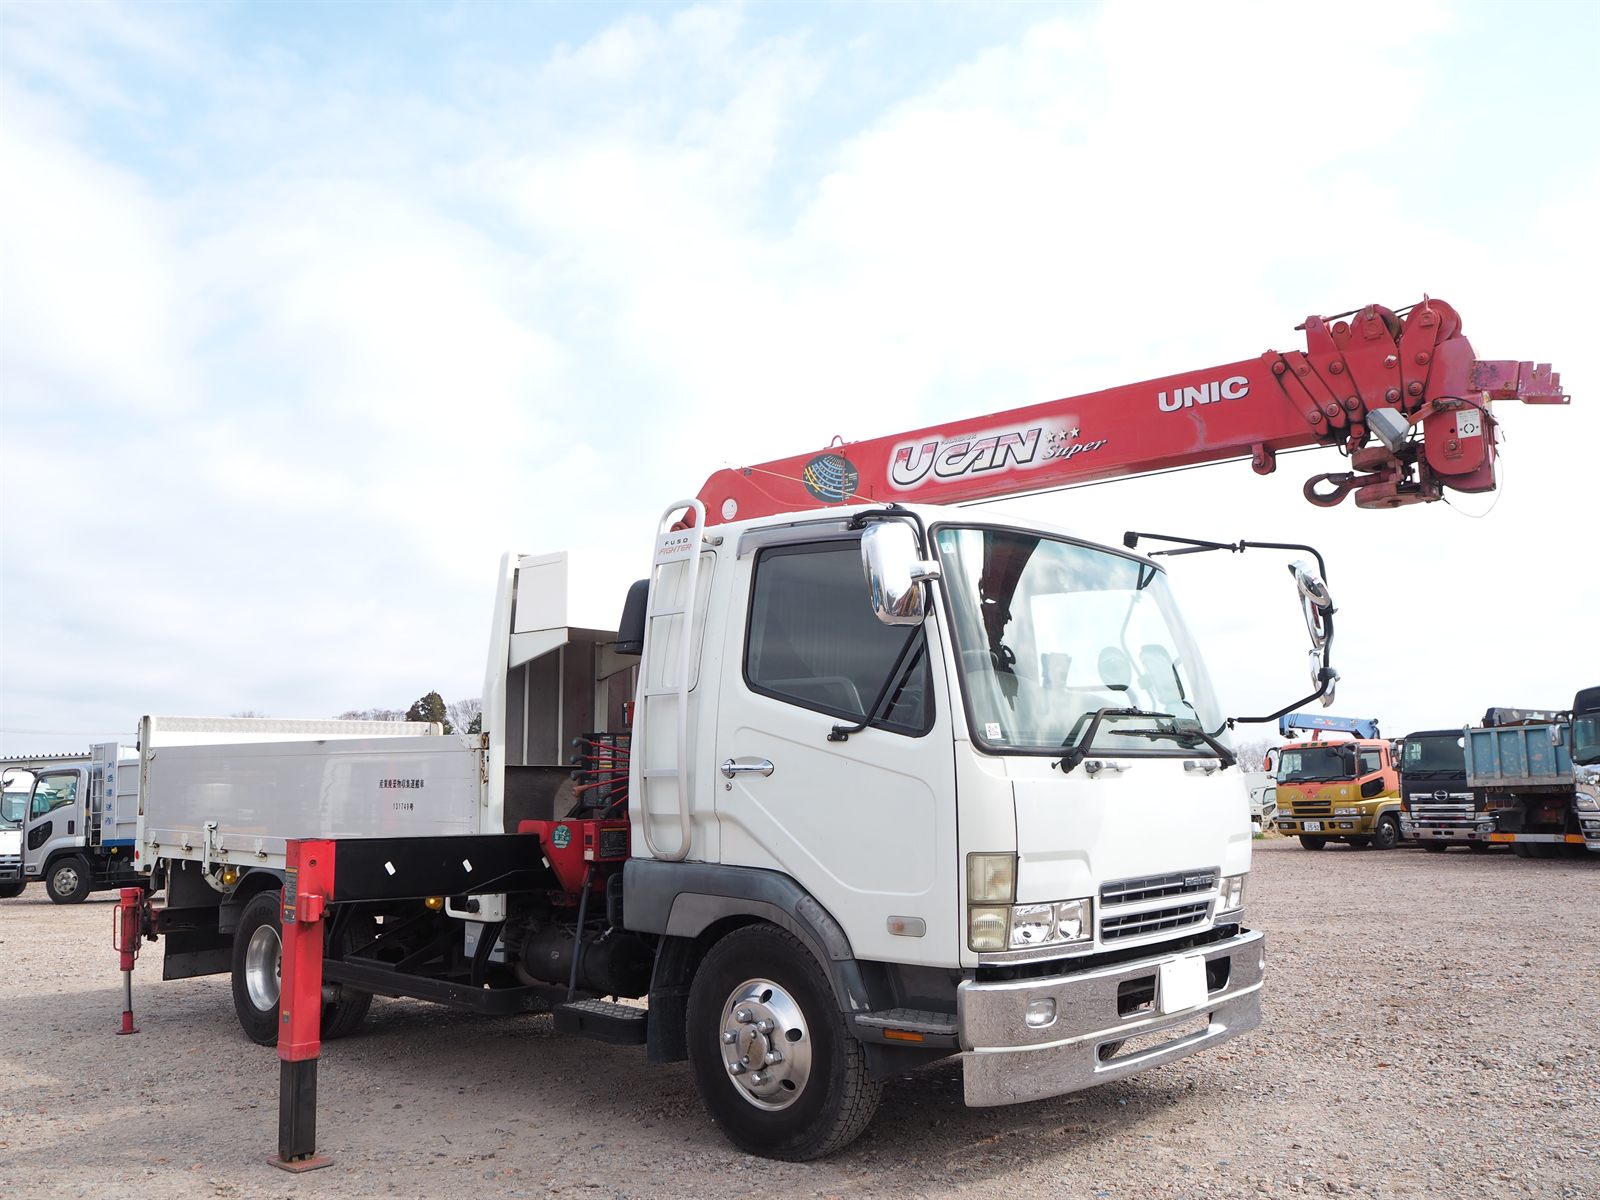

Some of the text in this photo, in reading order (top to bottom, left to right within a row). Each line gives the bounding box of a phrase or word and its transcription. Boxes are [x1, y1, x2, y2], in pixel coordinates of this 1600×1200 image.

[1158, 376, 1249, 413] UNIC
[892, 428, 1042, 486] UCAN
[1042, 439, 1108, 460] Super
[657, 544, 693, 555] FIGHTER
[664, 538, 689, 546] FUSO
